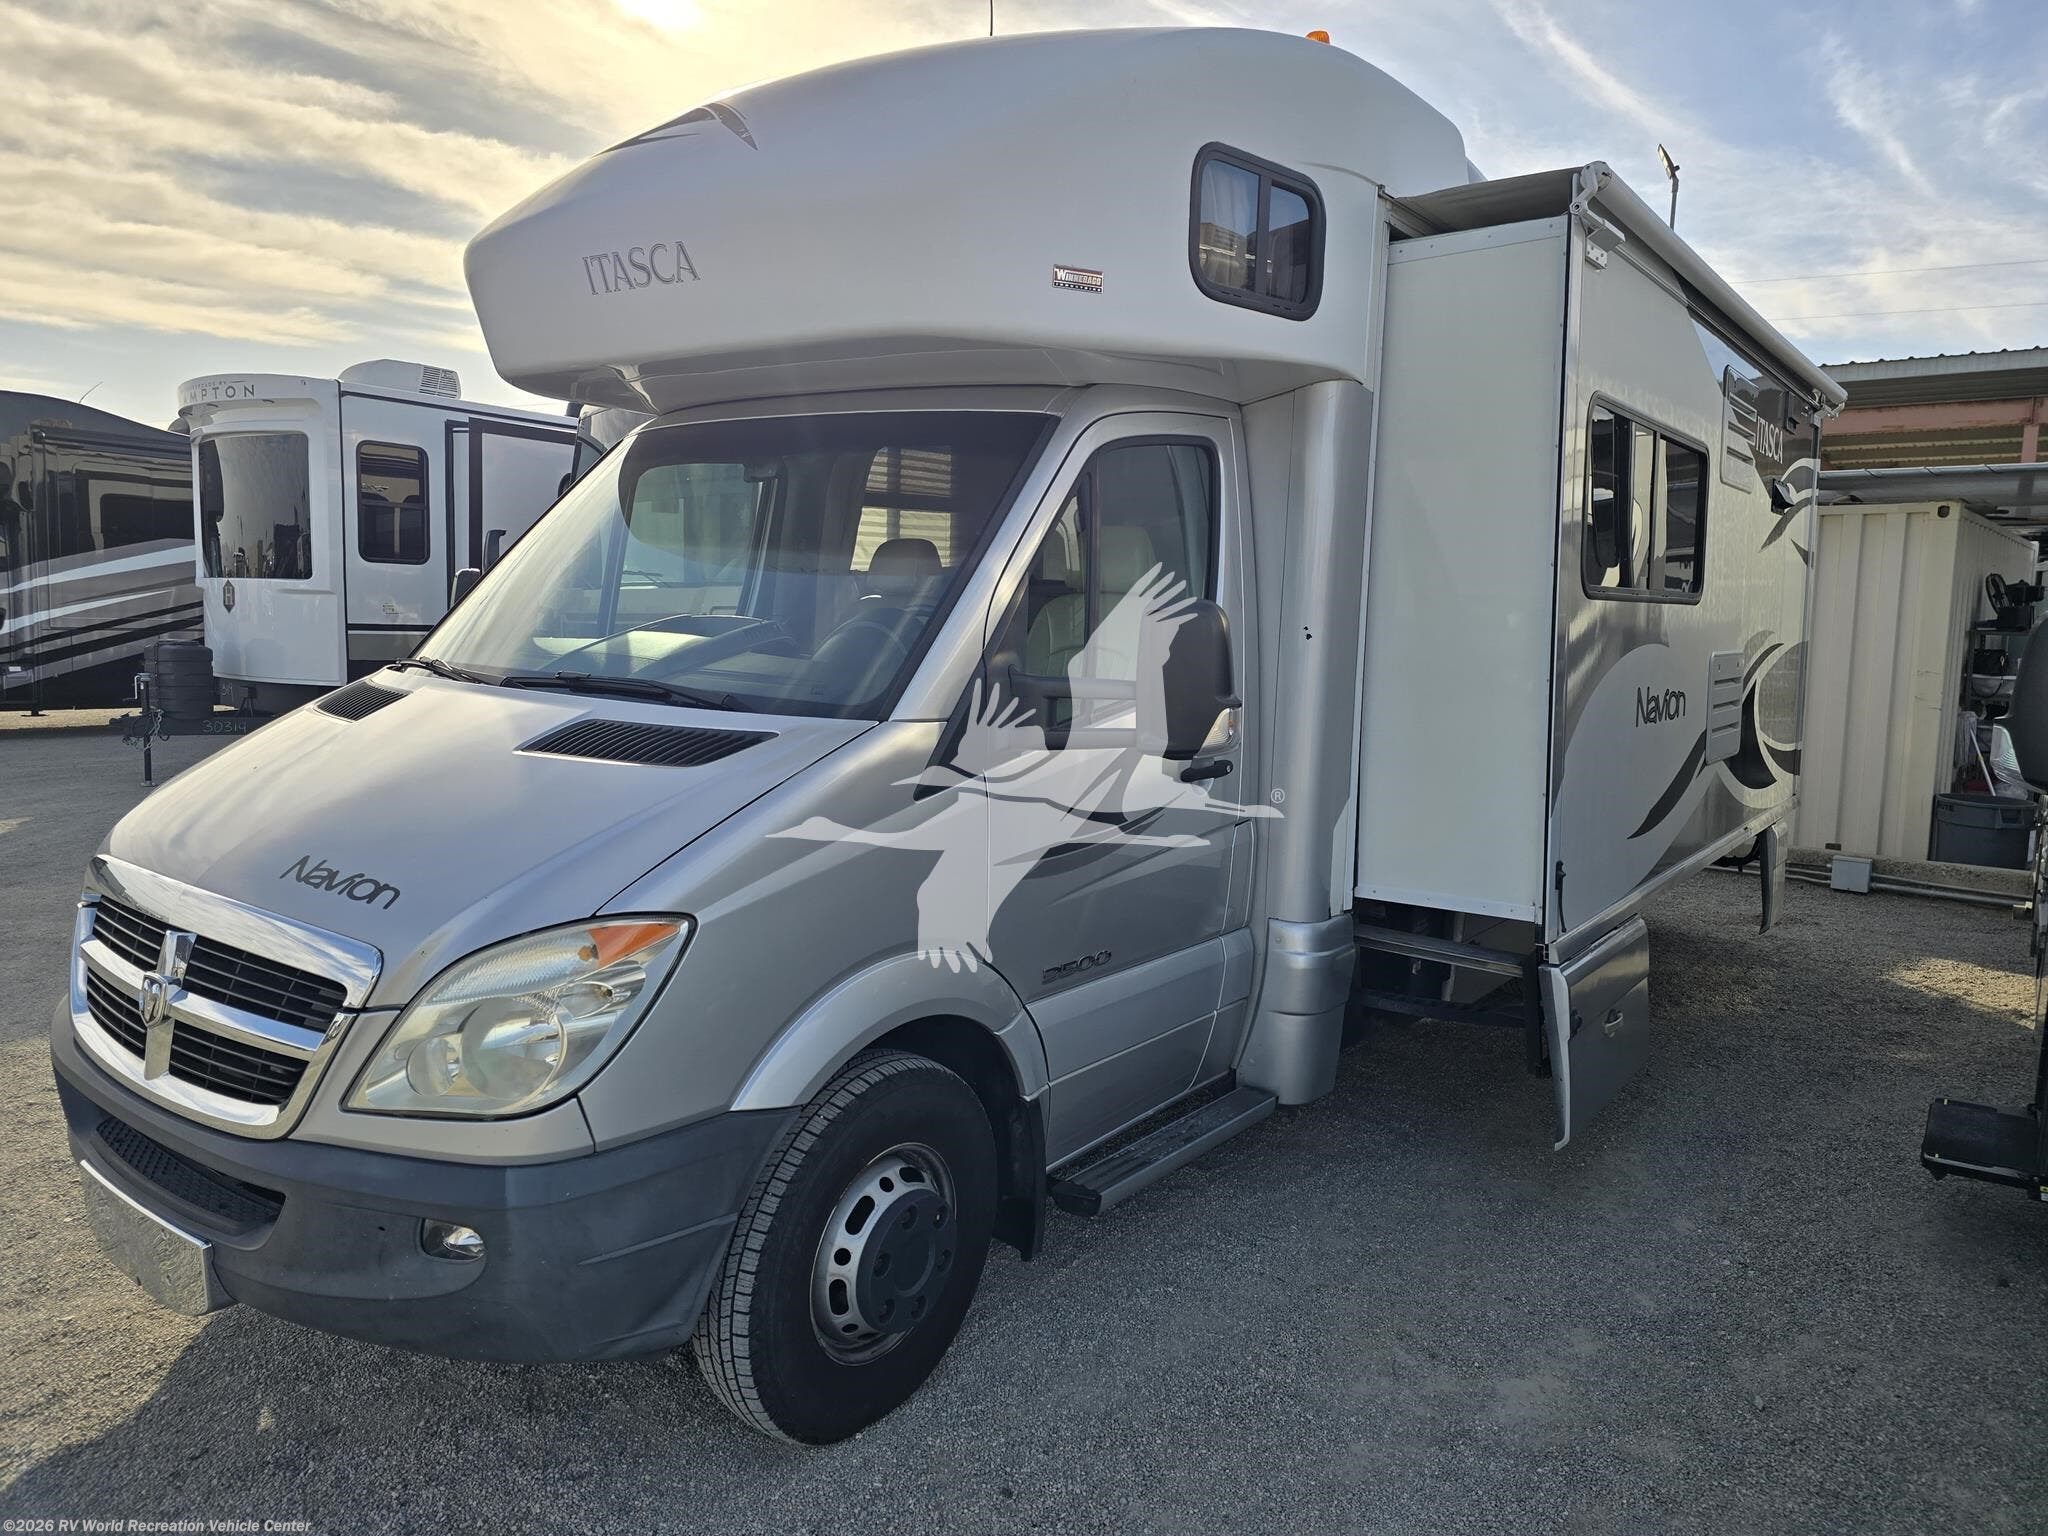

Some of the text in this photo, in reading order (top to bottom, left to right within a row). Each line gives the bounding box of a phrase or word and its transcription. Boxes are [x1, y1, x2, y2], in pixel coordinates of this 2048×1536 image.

[582, 240, 701, 295] ITASCA
[1755, 415, 1783, 465] ITASCA
[1635, 686, 1686, 728] Navion
[279, 855, 400, 910] Navion
[1041, 950, 1112, 985] 2500
